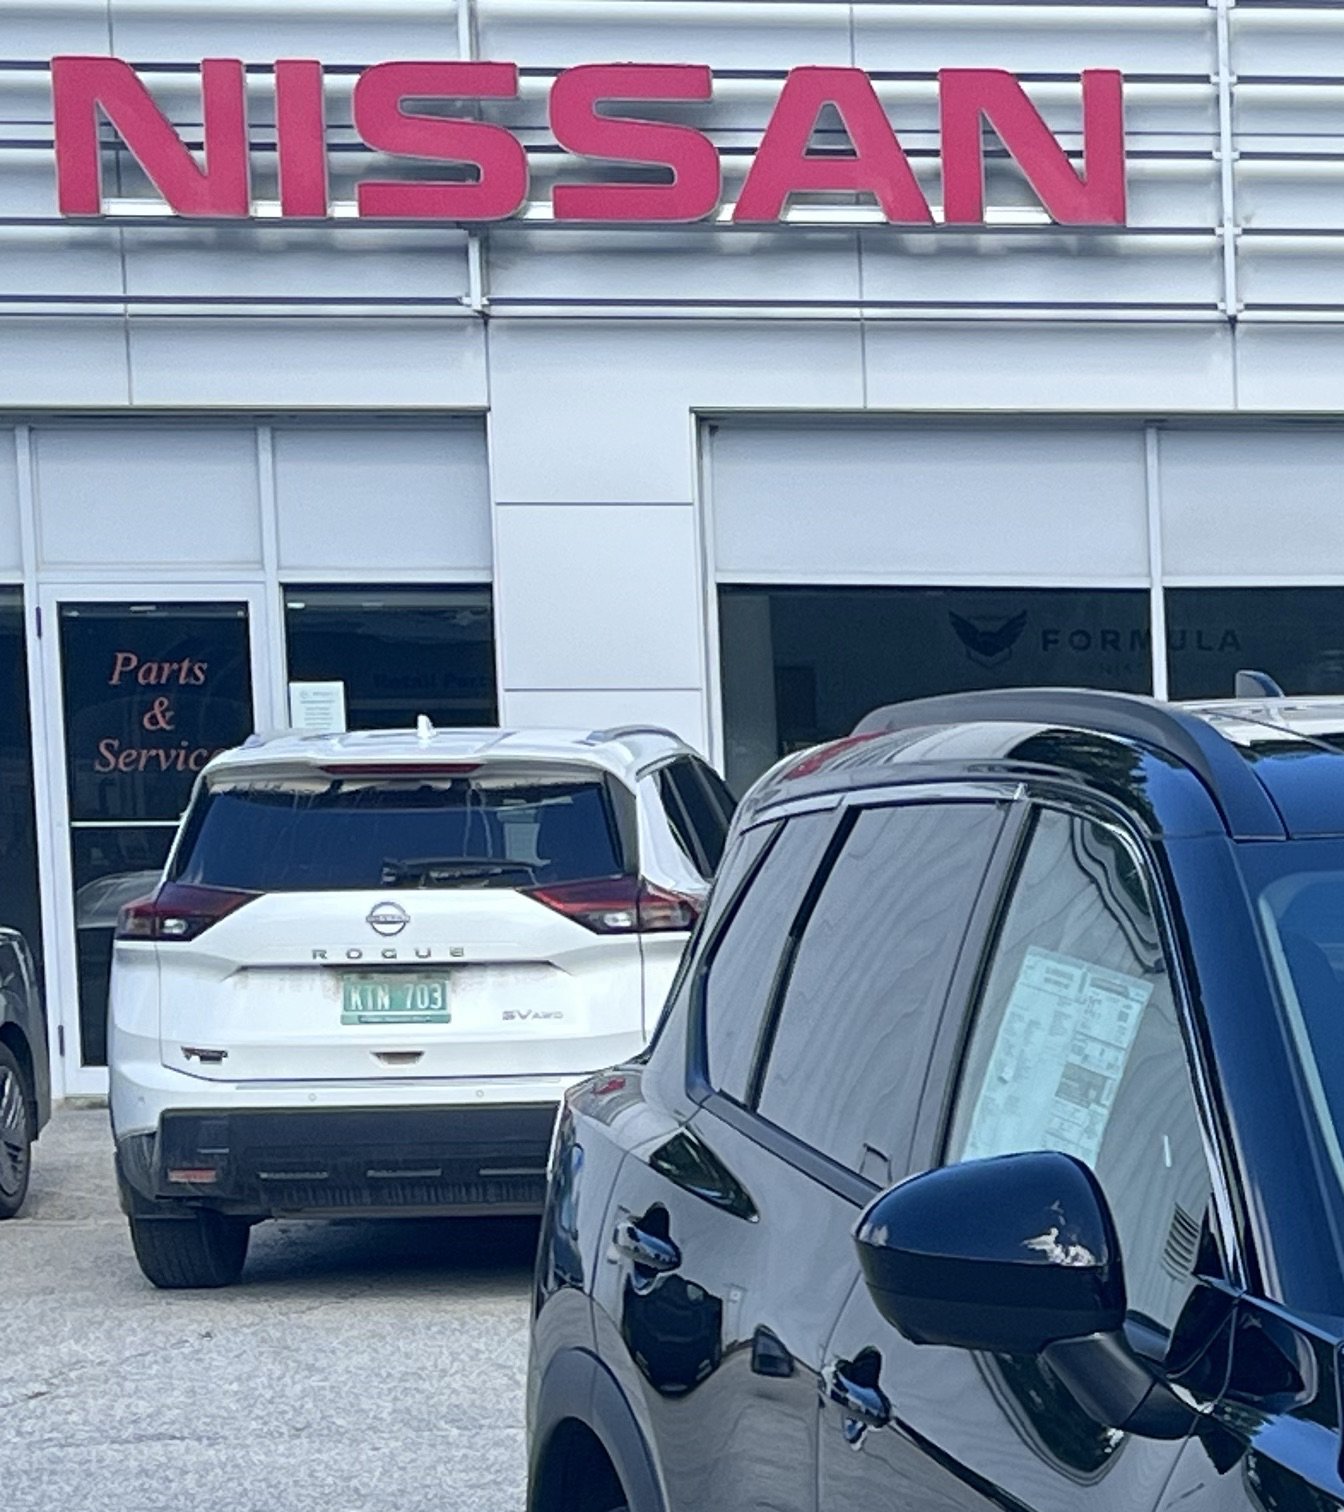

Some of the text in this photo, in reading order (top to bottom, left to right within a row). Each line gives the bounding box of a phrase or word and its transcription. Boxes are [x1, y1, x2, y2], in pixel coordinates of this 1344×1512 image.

[51, 56, 1126, 225] NISSAN
[108, 651, 208, 686] Parts
[142, 696, 175, 731] &
[94, 738, 226, 772] Servic
[312, 946, 465, 960] ROGUE
[403, 982, 443, 1010] 703
